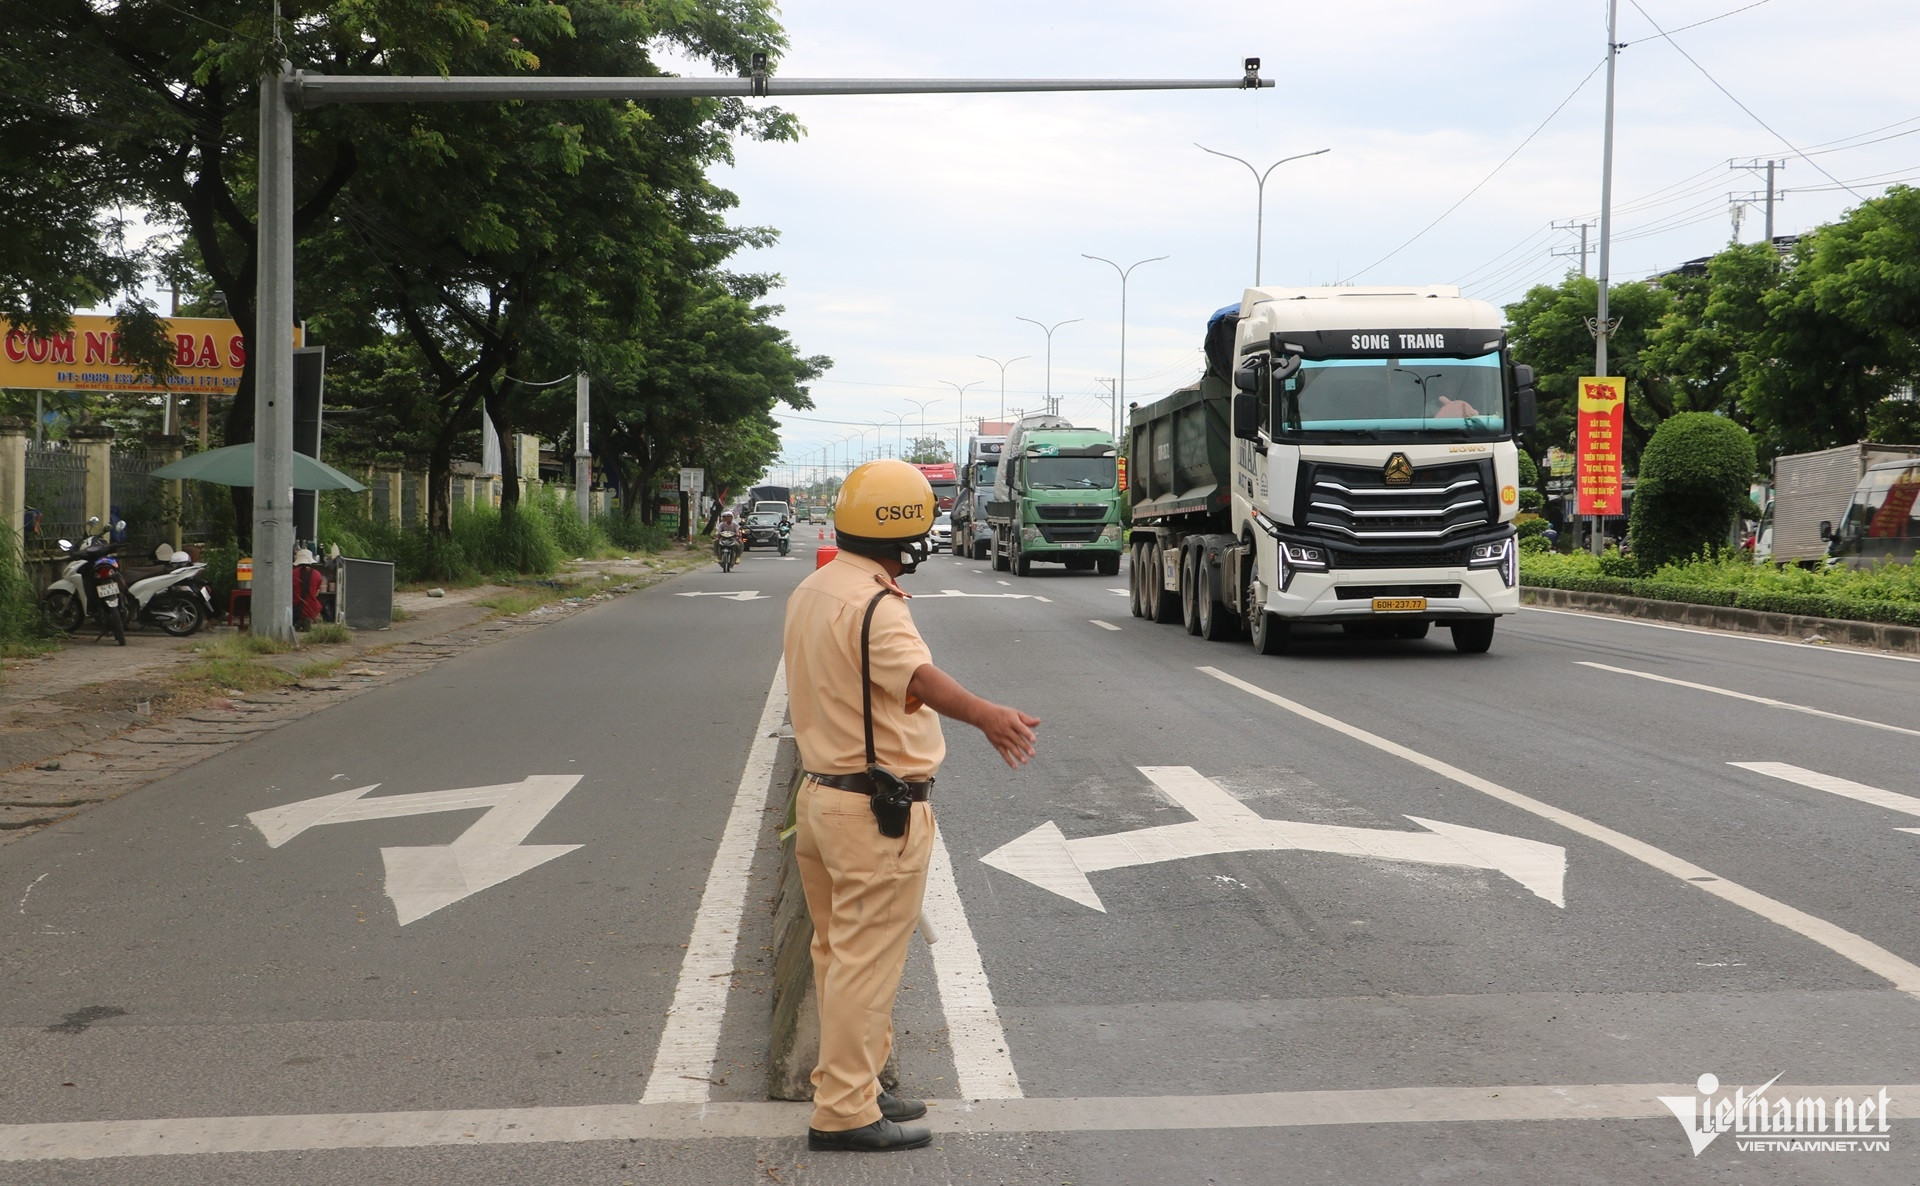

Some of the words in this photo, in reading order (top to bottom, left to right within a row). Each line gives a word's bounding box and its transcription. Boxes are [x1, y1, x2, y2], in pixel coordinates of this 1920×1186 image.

[1351, 334, 1390, 350] SONG
[1398, 333, 1445, 349] TRANG
[174, 333, 221, 368] BA
[81, 373, 110, 383] 0989
[1503, 488, 1515, 502] 06
[875, 503, 924, 521] CSGT
